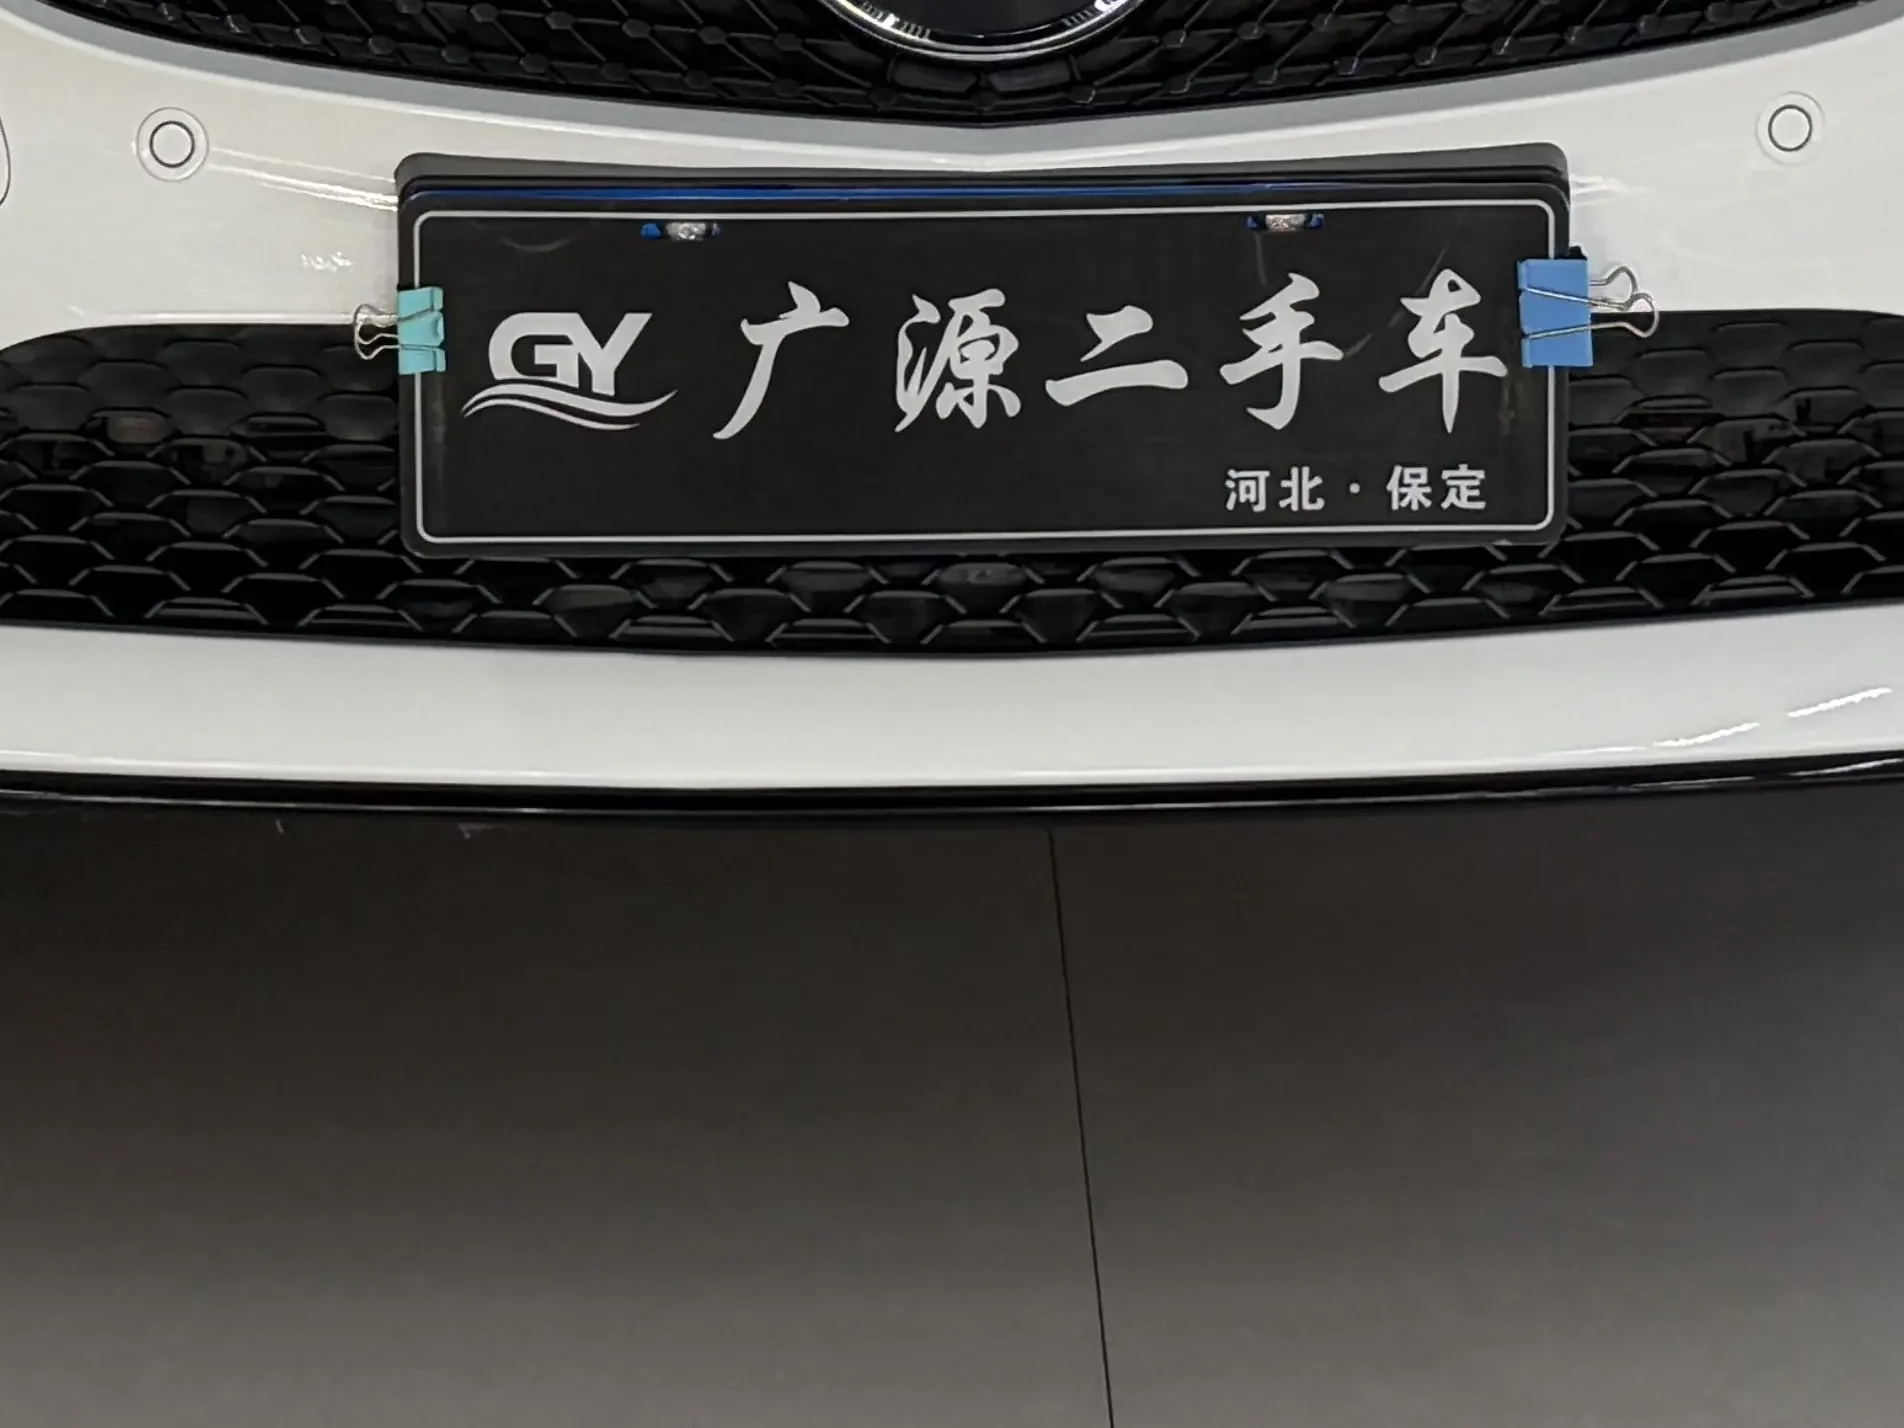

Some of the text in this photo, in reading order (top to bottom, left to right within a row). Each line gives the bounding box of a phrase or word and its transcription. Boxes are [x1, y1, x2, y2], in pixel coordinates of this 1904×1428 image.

[488, 268, 1508, 440] GY 广源二手车
[1224, 464, 1486, 513] 河北·保定
